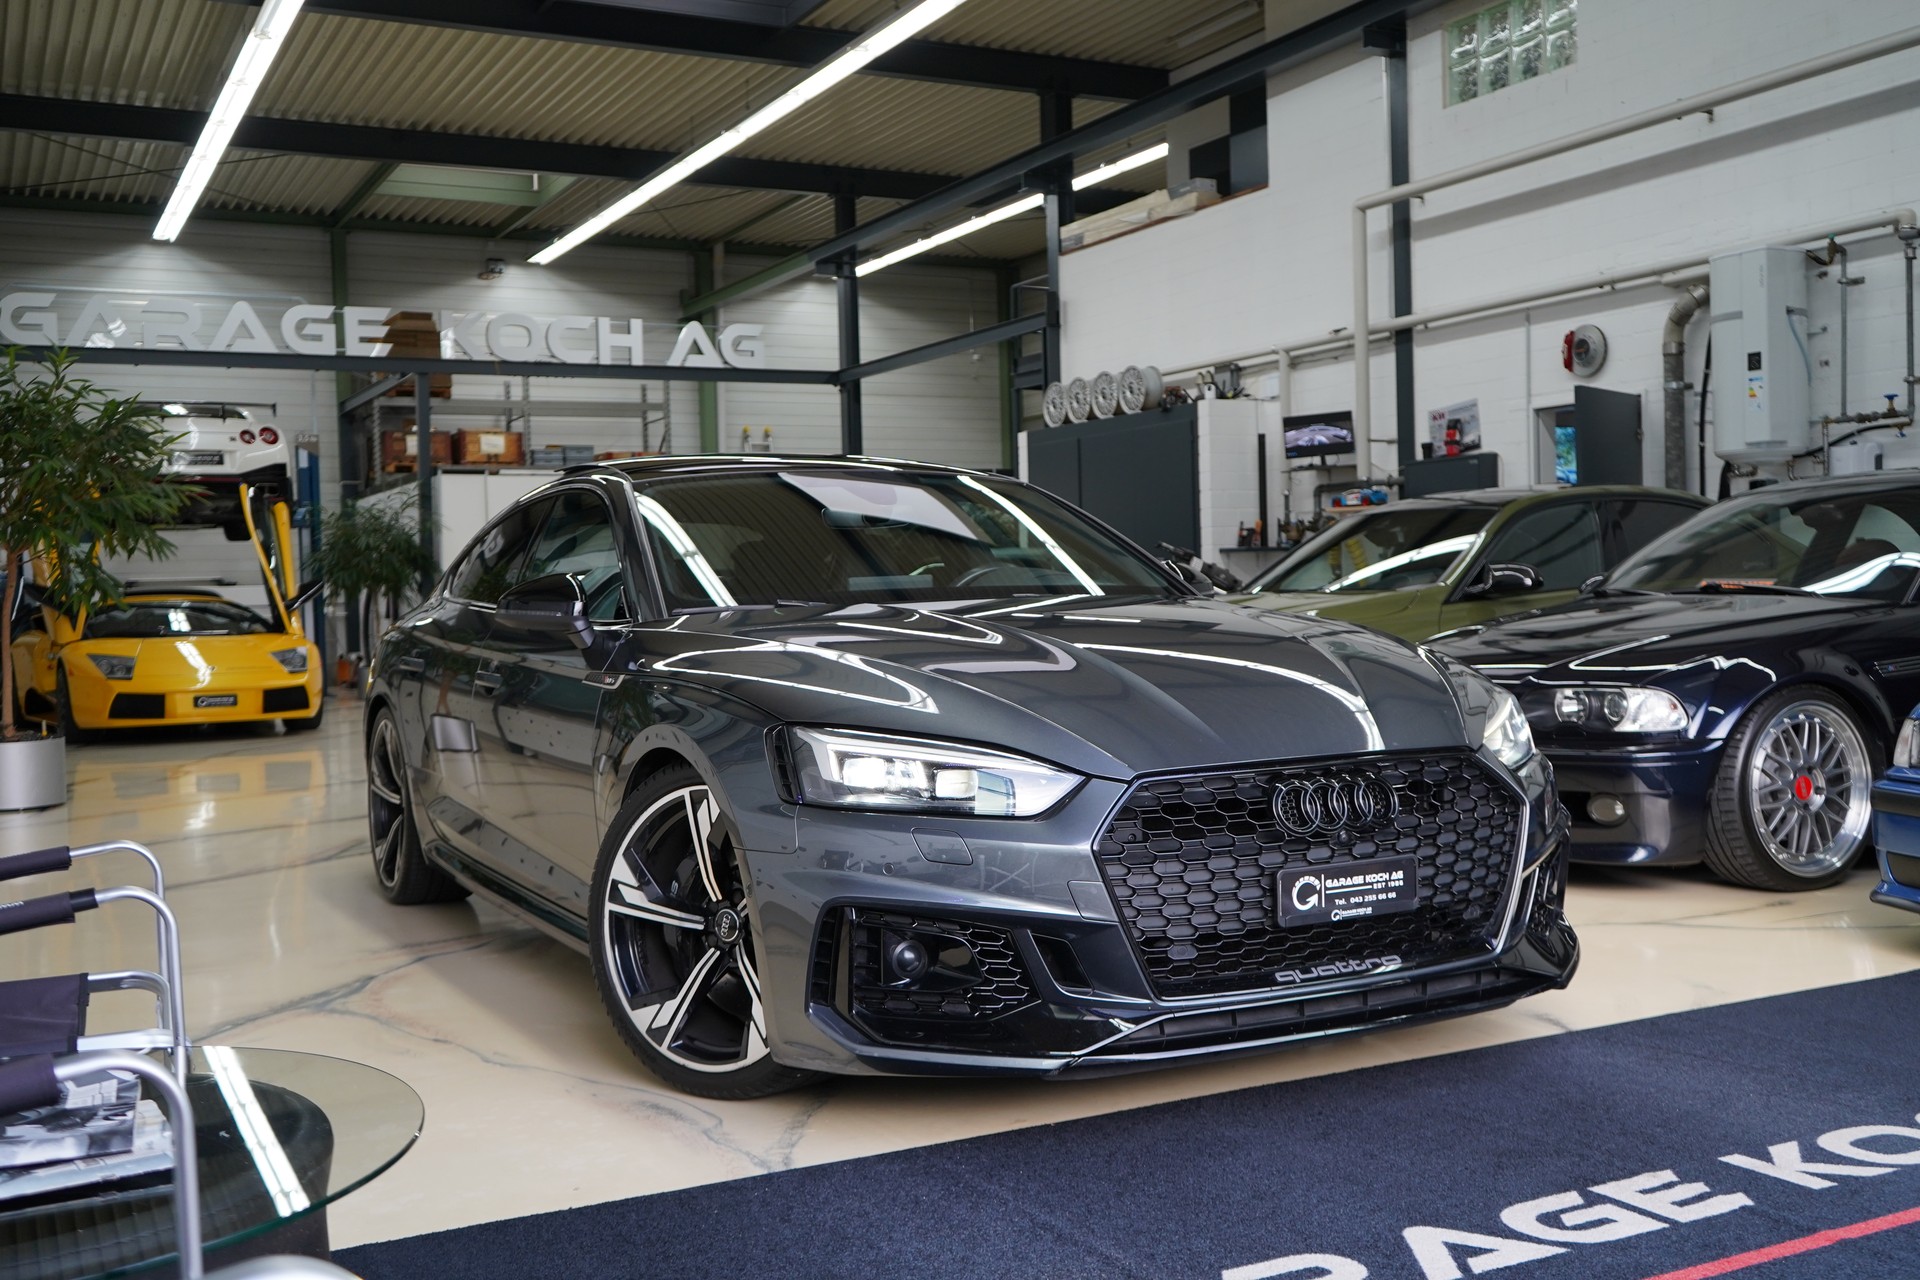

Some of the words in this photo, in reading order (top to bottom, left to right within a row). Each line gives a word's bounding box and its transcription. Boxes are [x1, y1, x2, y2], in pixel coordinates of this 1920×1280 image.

[0, 292, 394, 358] GARAGE
[440, 312, 644, 366] KOCH
[666, 320, 766, 370] AG
[1325, 875, 1364, 888] GARAGE
[1365, 872, 1389, 883] KOCH
[1390, 870, 1404, 880] AG
[1373, 882, 1386, 890] EST
[1334, 898, 1347, 906] Tel.
[1350, 896, 1363, 904] 043
[1364, 894, 1377, 902] 255
[1274, 954, 1402, 983] quattro
[1718, 1112, 1920, 1189] KO
